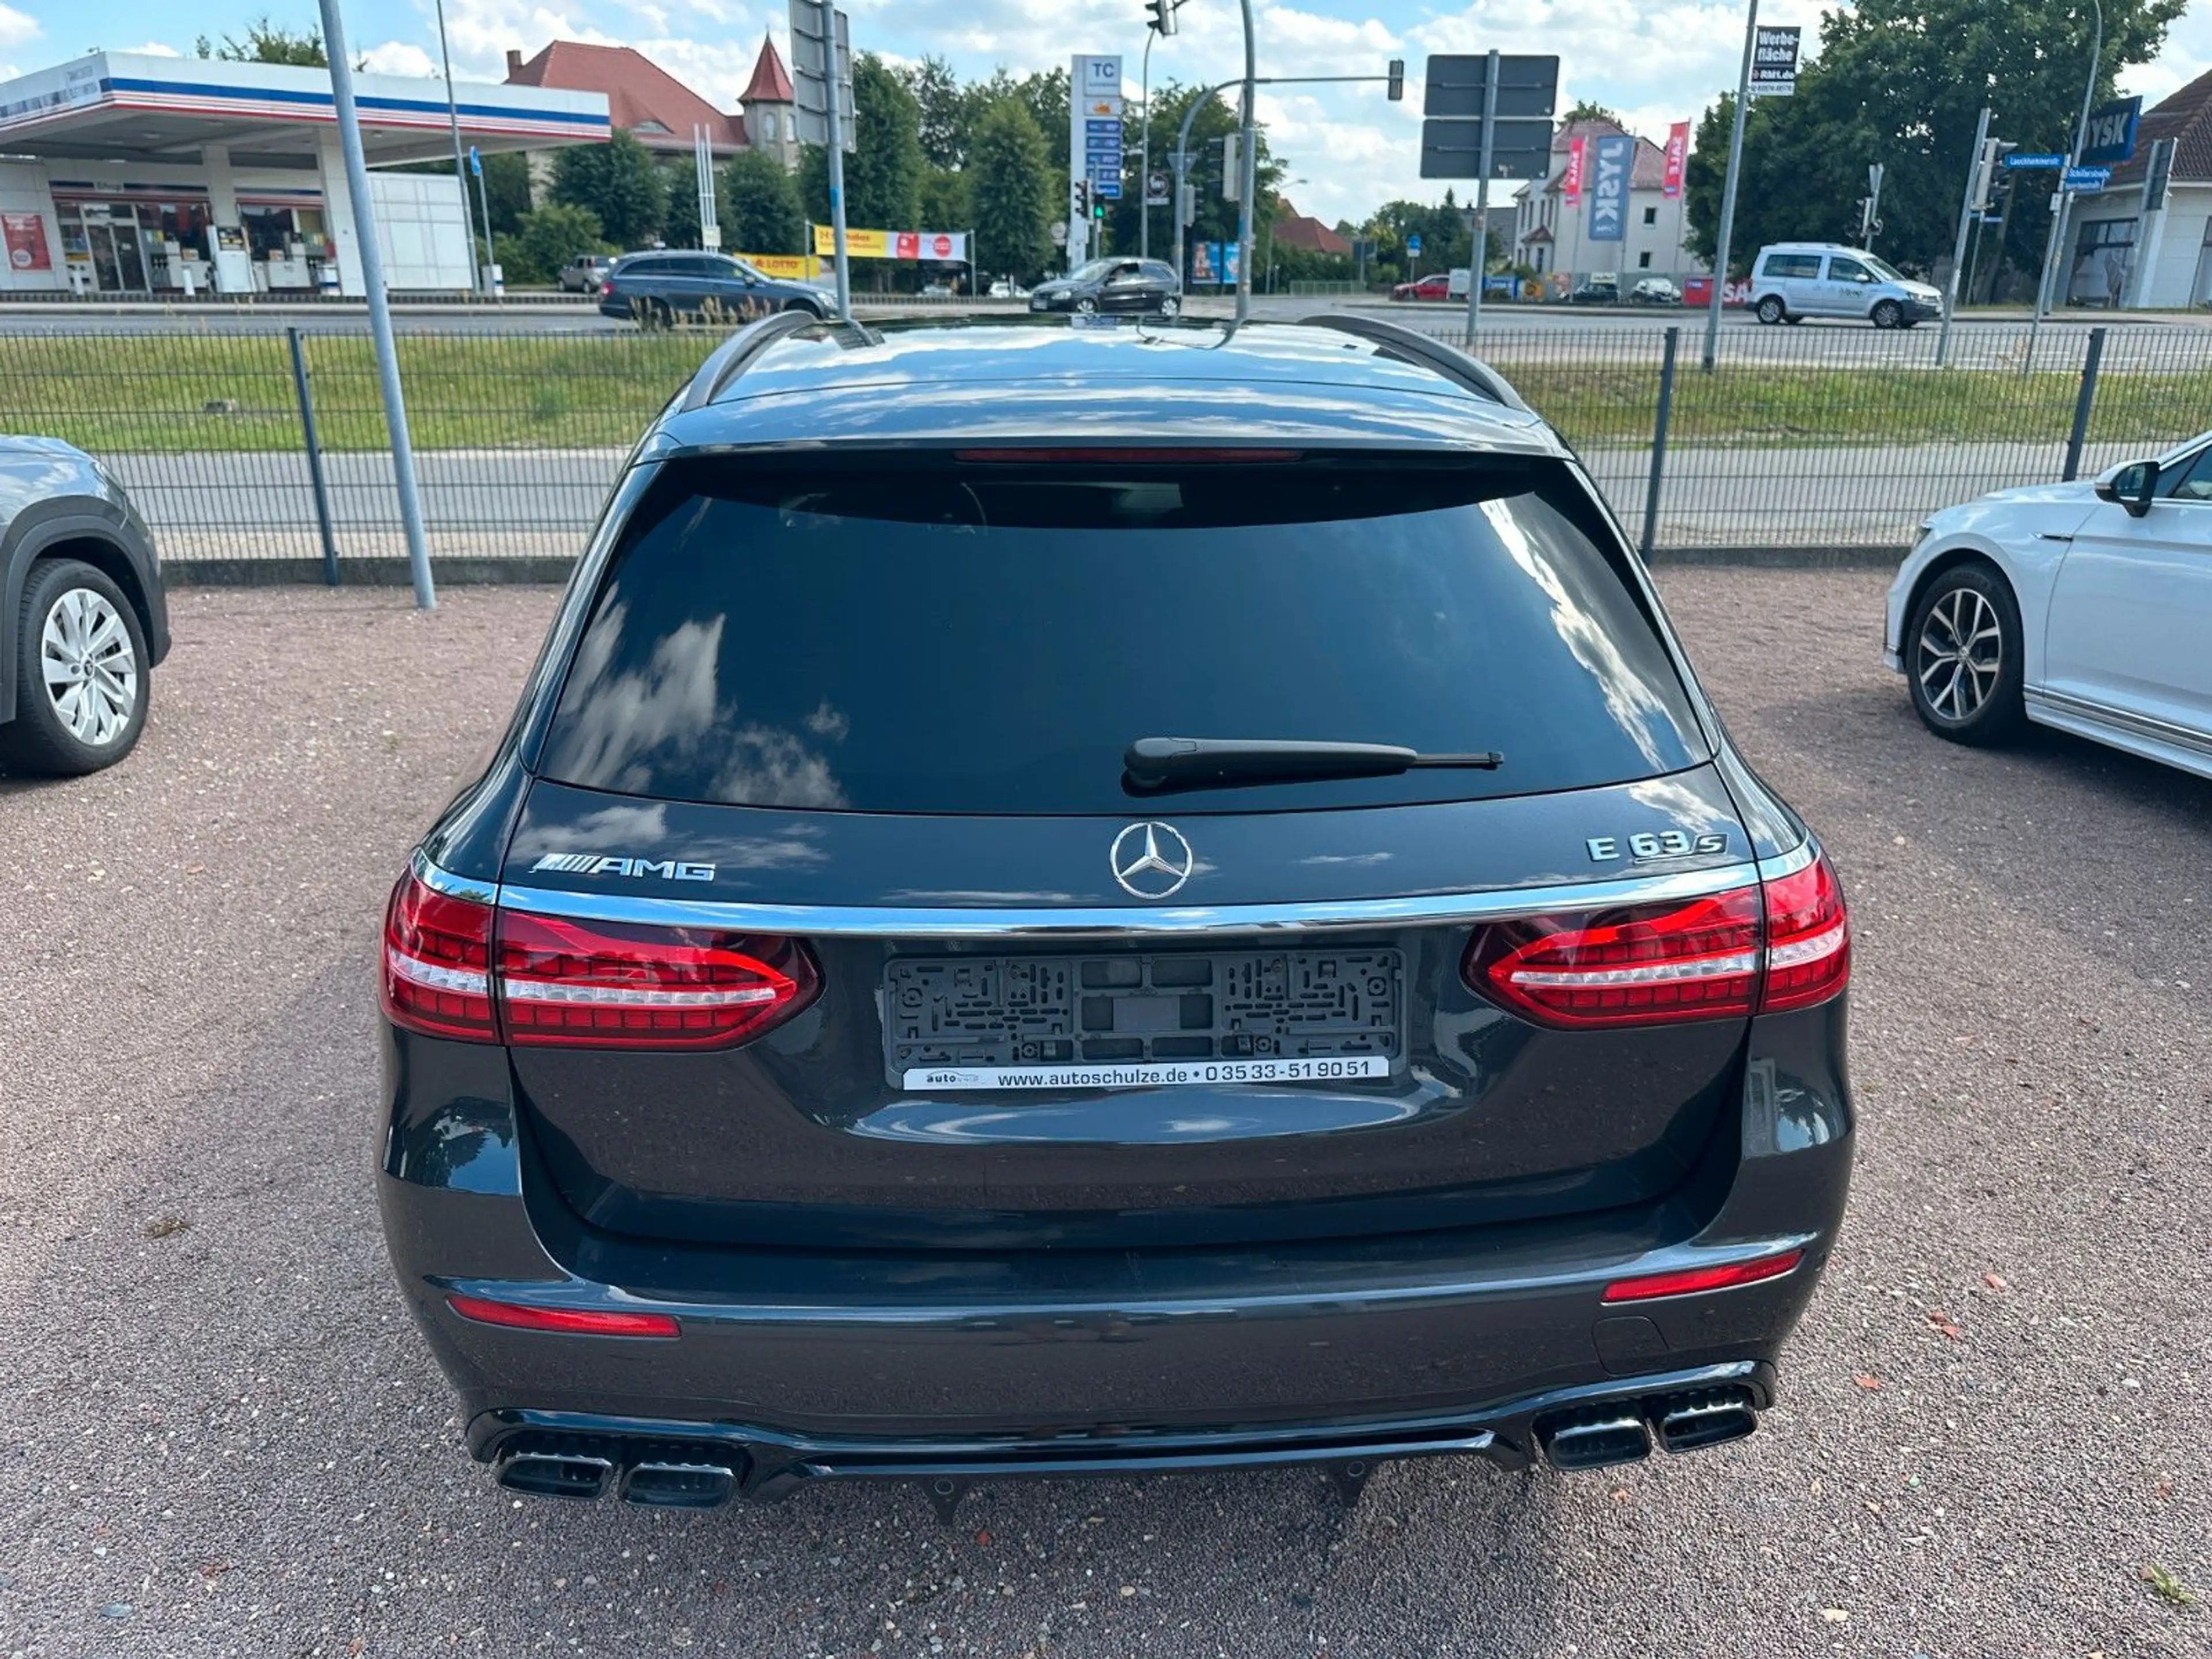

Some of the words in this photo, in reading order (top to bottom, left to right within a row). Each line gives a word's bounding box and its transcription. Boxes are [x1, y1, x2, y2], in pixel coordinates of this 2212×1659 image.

[1759, 31, 1798, 46] Werbe-
[1758, 47, 1793, 62] fläche
[1092, 63, 1115, 78] TC
[1586, 837, 1620, 862] E
[586, 857, 716, 882] AMG
[926, 1073, 956, 1083] auto
[998, 1067, 1187, 1086] www.autoschulze.de
